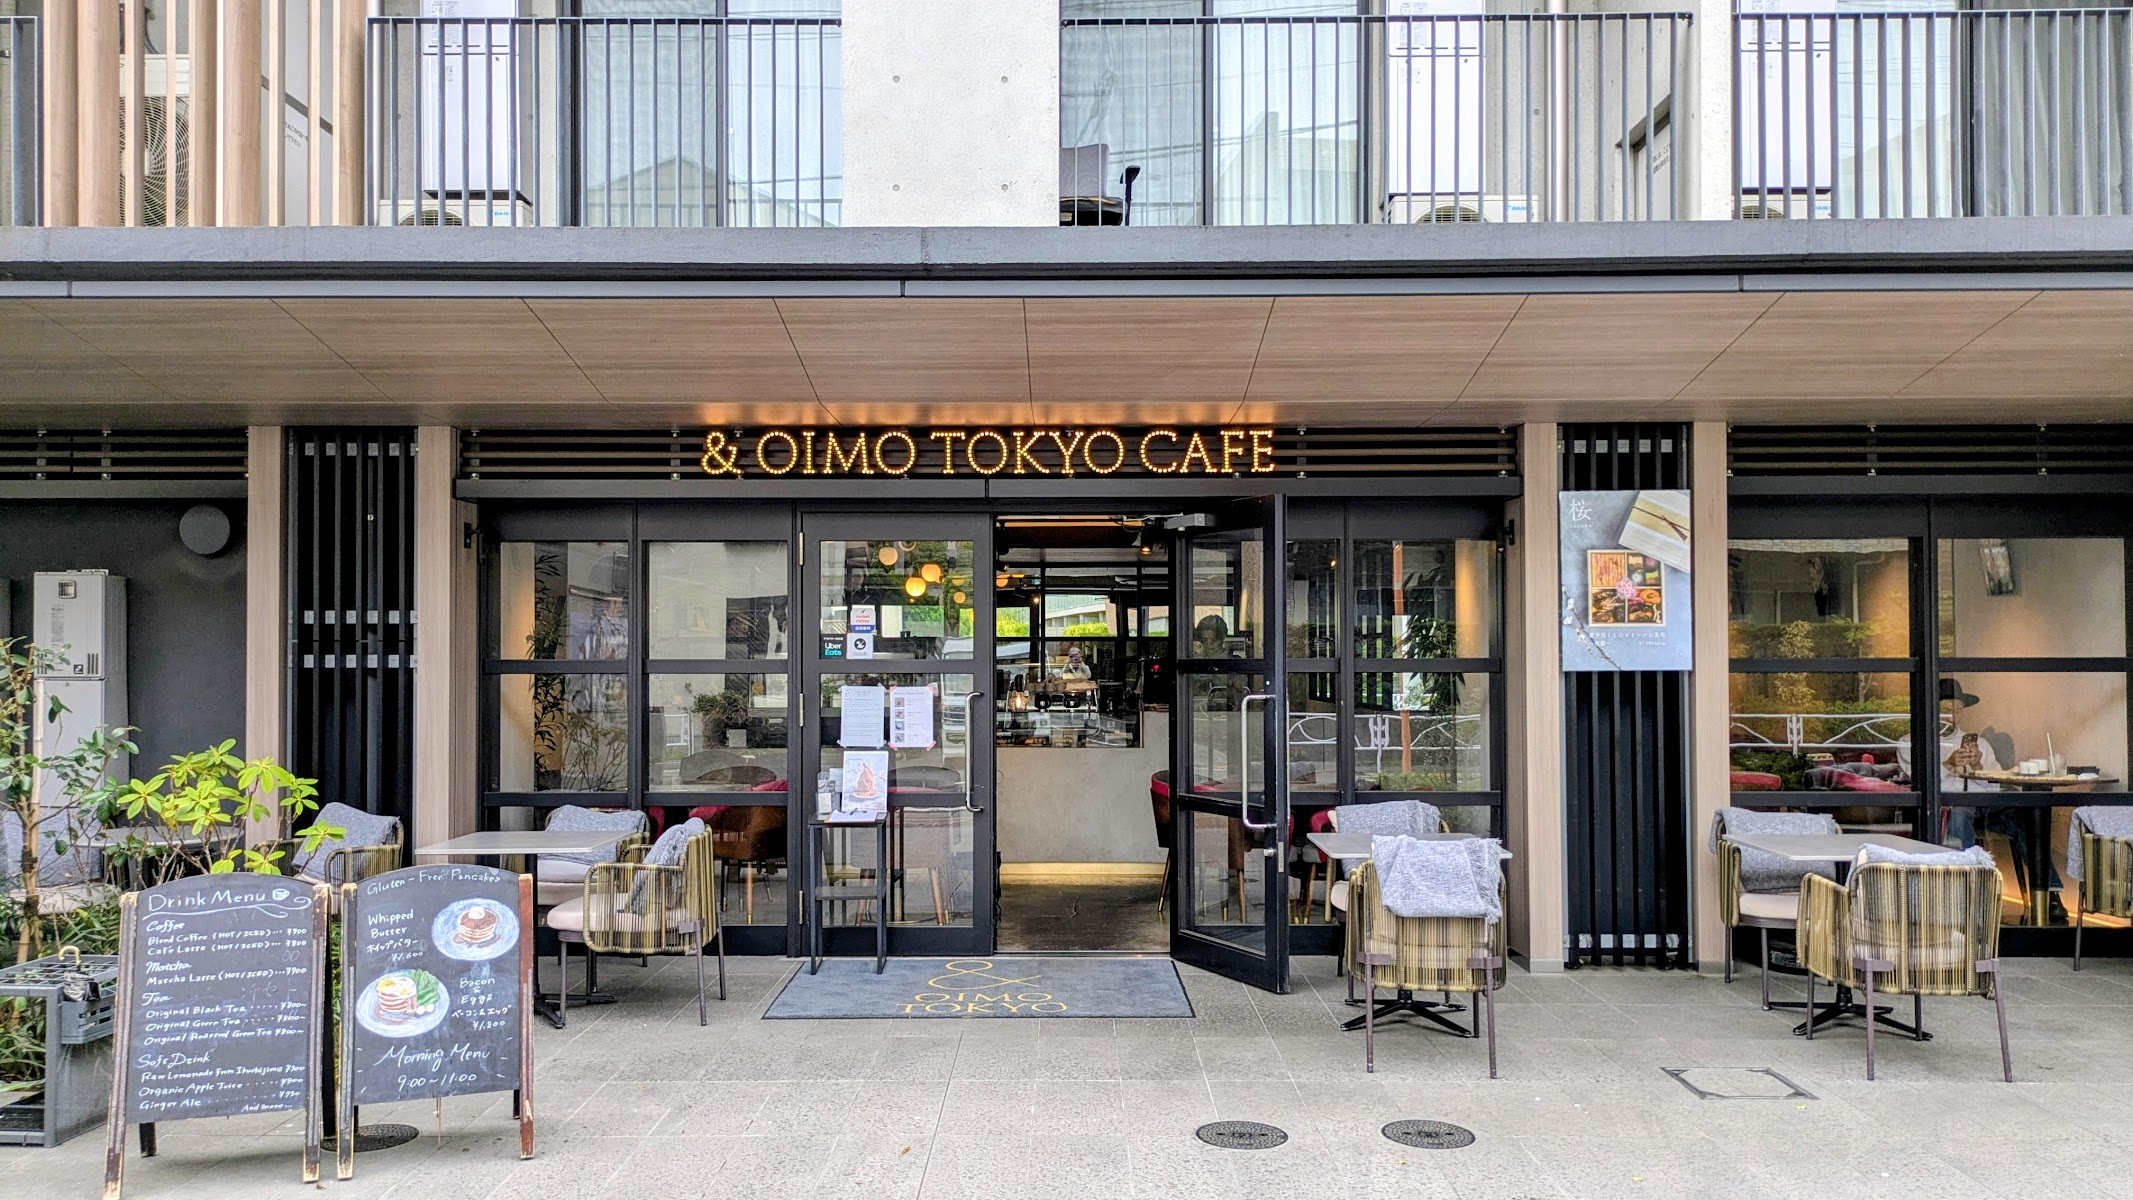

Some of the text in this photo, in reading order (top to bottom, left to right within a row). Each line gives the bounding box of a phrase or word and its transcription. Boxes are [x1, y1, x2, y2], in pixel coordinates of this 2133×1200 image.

[701, 430, 1277, 475] & OIMO TOKYO CAFE
[1568, 498, 1592, 521] 桜
[824, 642, 842, 650] Uber
[367, 879, 405, 895] Gluten
[149, 890, 265, 911] Drink Menu
[368, 908, 414, 926] Whipped
[146, 919, 185, 932] Coffee
[371, 926, 408, 939] Butter
[148, 935, 174, 946] Blend
[176, 933, 208, 943] Coffee
[177, 945, 206, 954] Latte
[145, 960, 192, 974] Matcha
[146, 974, 186, 986] Matcha
[189, 973, 217, 982] Latte
[460, 977, 496, 988] Bacon
[141, 992, 173, 1006] Tea
[461, 993, 493, 1006] Eggs
[915, 992, 1052, 1002] OIMO
[145, 1006, 190, 1019] Original
[193, 1004, 221, 1015] Black
[225, 1004, 247, 1014] Tea
[896, 1002, 1068, 1013] TOKYO
[145, 1020, 190, 1032] Original
[193, 1019, 219, 1028] Green
[221, 1017, 241, 1027] Tea
[144, 1032, 187, 1046] Original
[256, 1027, 272, 1037] Tea
[138, 1052, 210, 1069] Soft Drink
[373, 1042, 490, 1072] Morning Menu
[141, 1071, 166, 1083] Raw
[168, 1068, 214, 1080] Lemonade
[138, 1086, 184, 1097] Organic
[185, 1082, 215, 1094] Apple
[217, 1082, 243, 1090] Juice
[140, 1100, 178, 1111] Ginger
[180, 1098, 202, 1107] Ale
[241, 1103, 260, 1112] And
